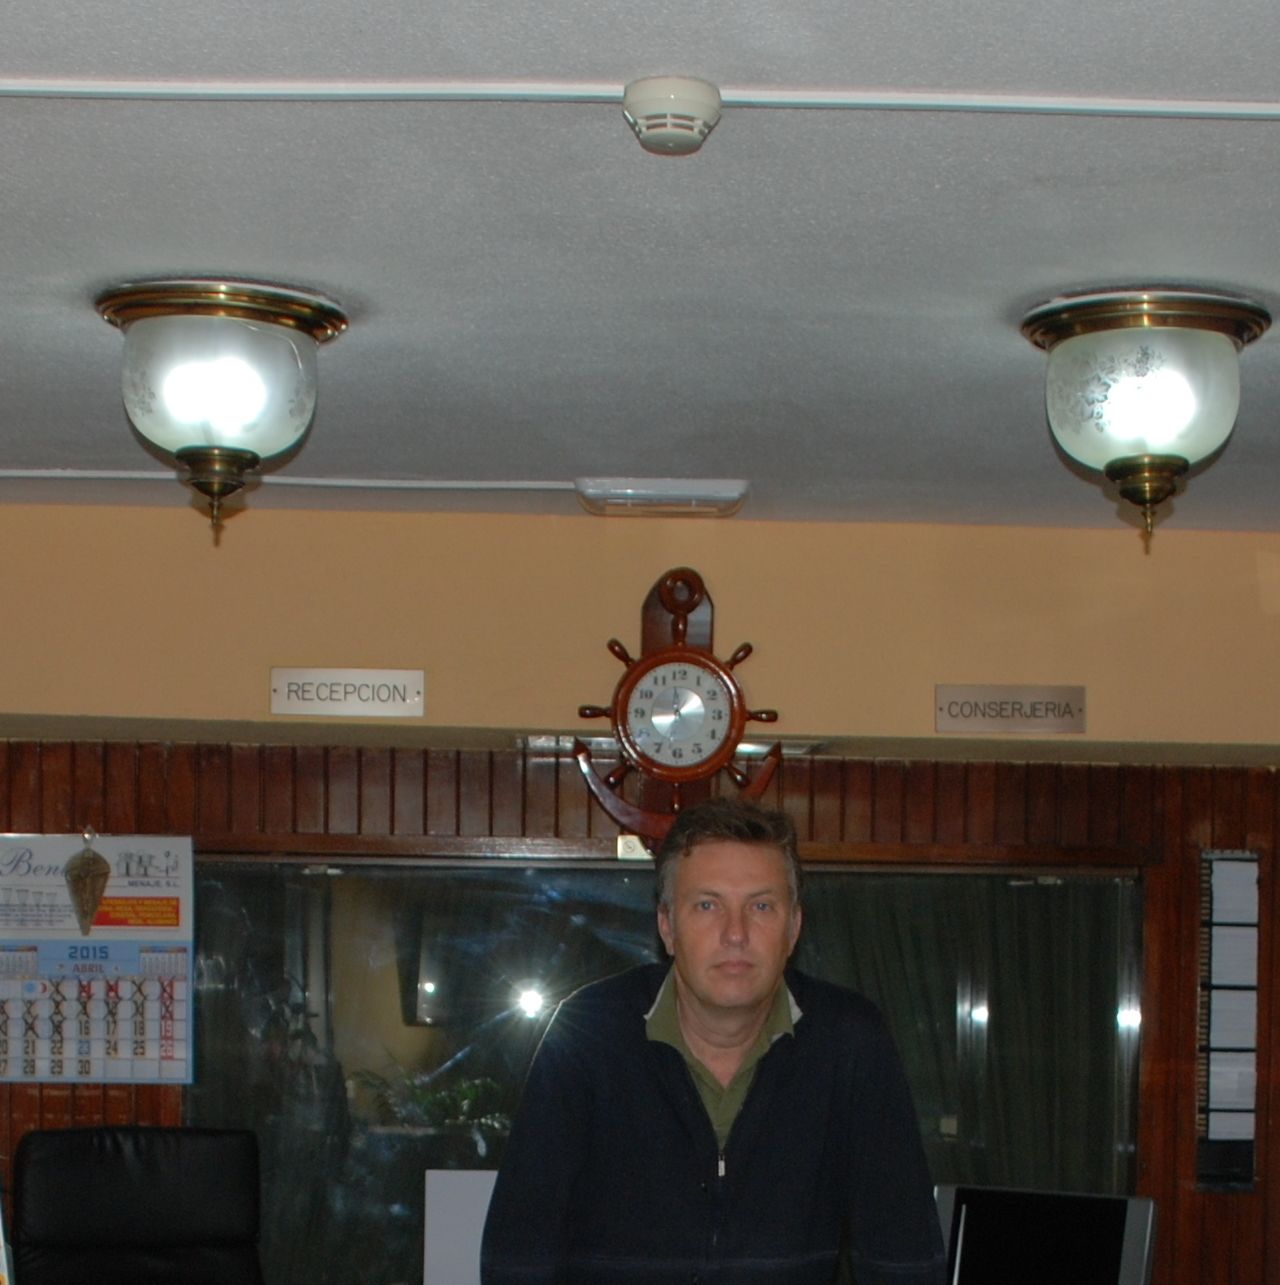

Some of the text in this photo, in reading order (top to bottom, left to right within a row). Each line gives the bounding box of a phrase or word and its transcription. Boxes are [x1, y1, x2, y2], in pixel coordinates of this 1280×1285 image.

[653, 675, 667, 686] 11
[672, 669, 688, 681] 12
[286, 681, 408, 703] RECEPCION
[639, 689, 653, 700] 10
[706, 690, 717, 701] 2
[634, 708, 645, 718] 9
[712, 709, 722, 721] 3
[947, 700, 1075, 719] CONSERJERIA
[68, 946, 110, 960] 2015
[72, 963, 105, 974] ABRIL
[78, 1021, 90, 1036] 16
[106, 1021, 118, 1036] 17
[133, 1021, 145, 1036] 18
[23, 1039, 36, 1055] 21
[51, 1039, 63, 1055] 22
[106, 1039, 118, 1055] 24
[133, 1040, 145, 1056] 25
[23, 1060, 36, 1075] 28
[51, 1060, 63, 1075] 29
[78, 1060, 91, 1075] 30
